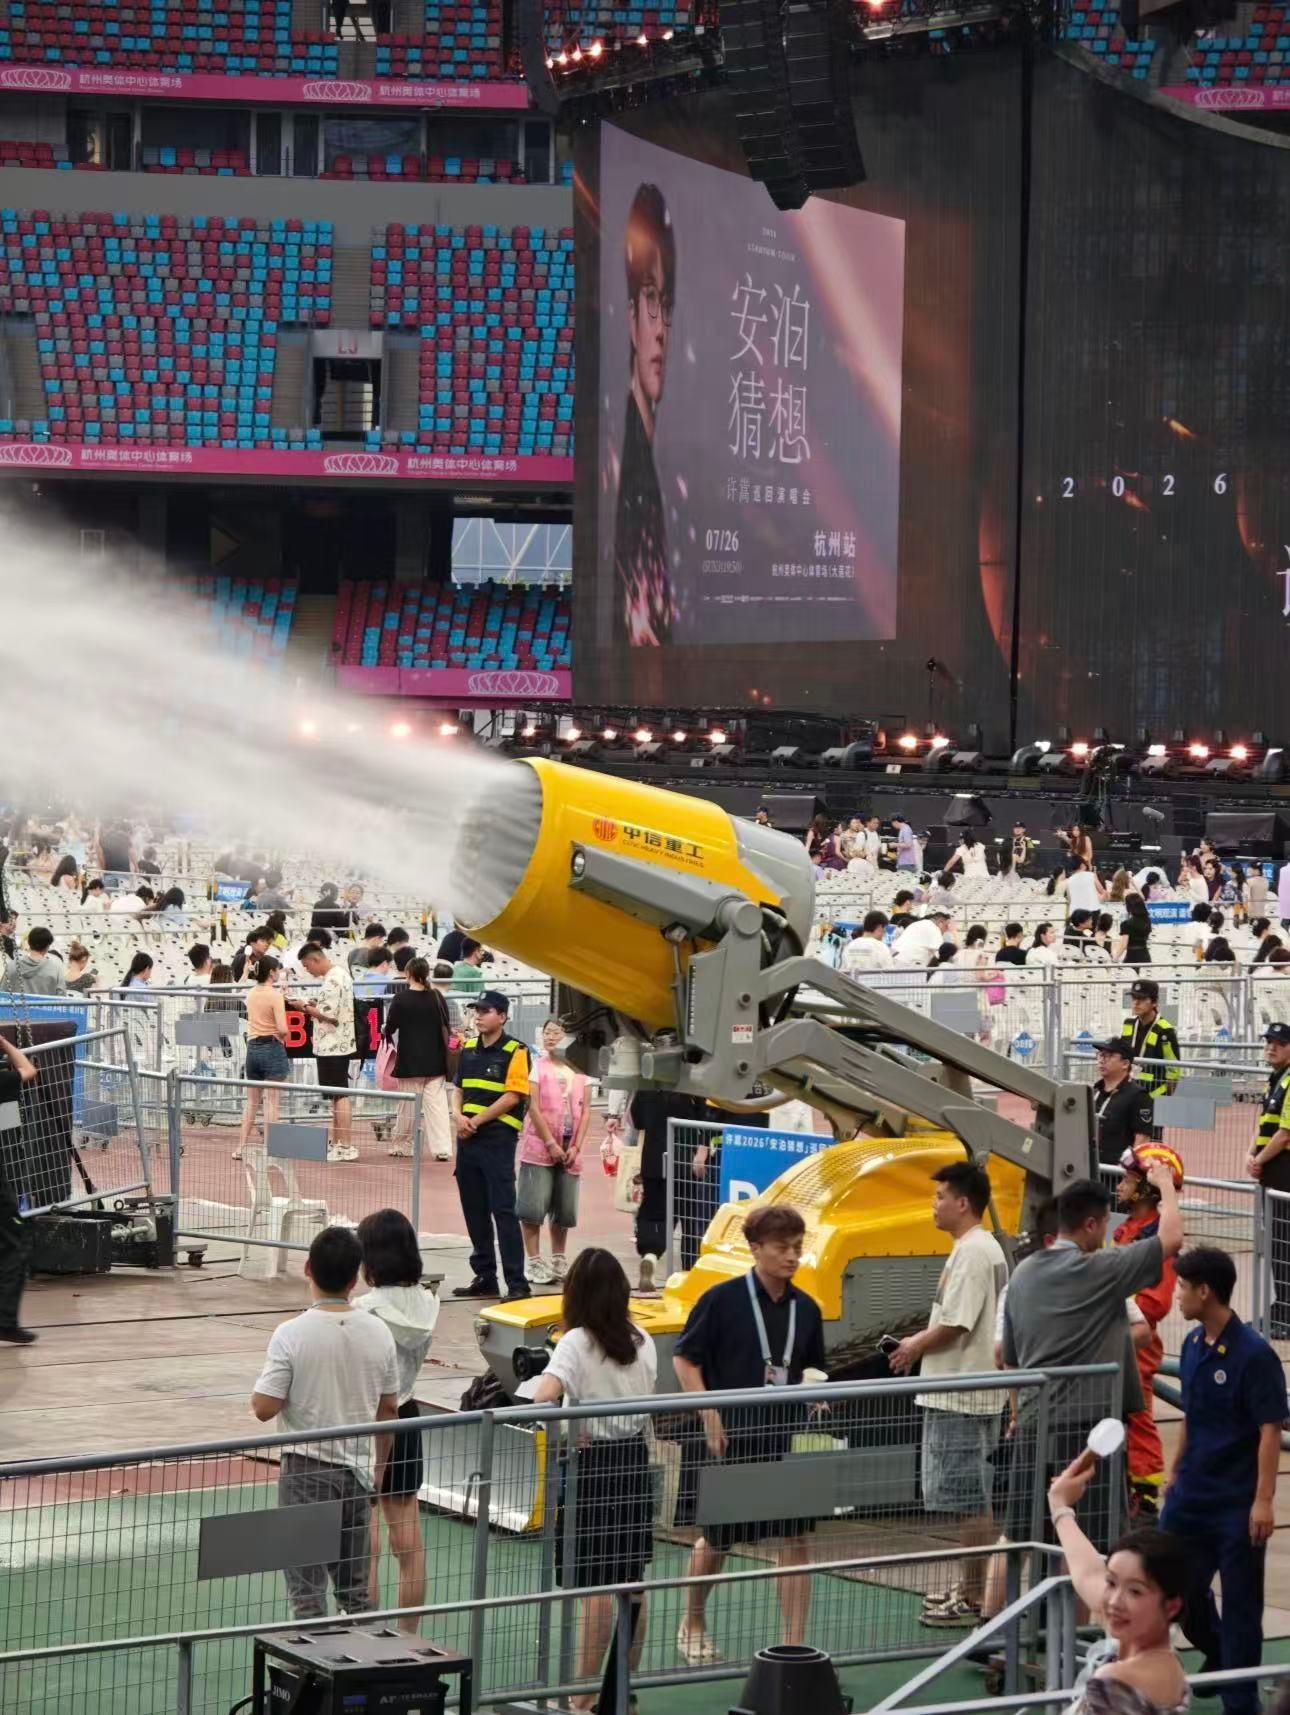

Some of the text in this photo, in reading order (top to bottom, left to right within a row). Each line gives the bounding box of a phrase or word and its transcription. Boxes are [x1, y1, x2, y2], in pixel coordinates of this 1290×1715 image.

[730, 272, 810, 370] 安泊
[728, 371, 811, 463] 猜想
[705, 529, 739, 551] 07/26
[814, 530, 856, 558] 杭州站
[623, 826, 704, 859] 中信重工
